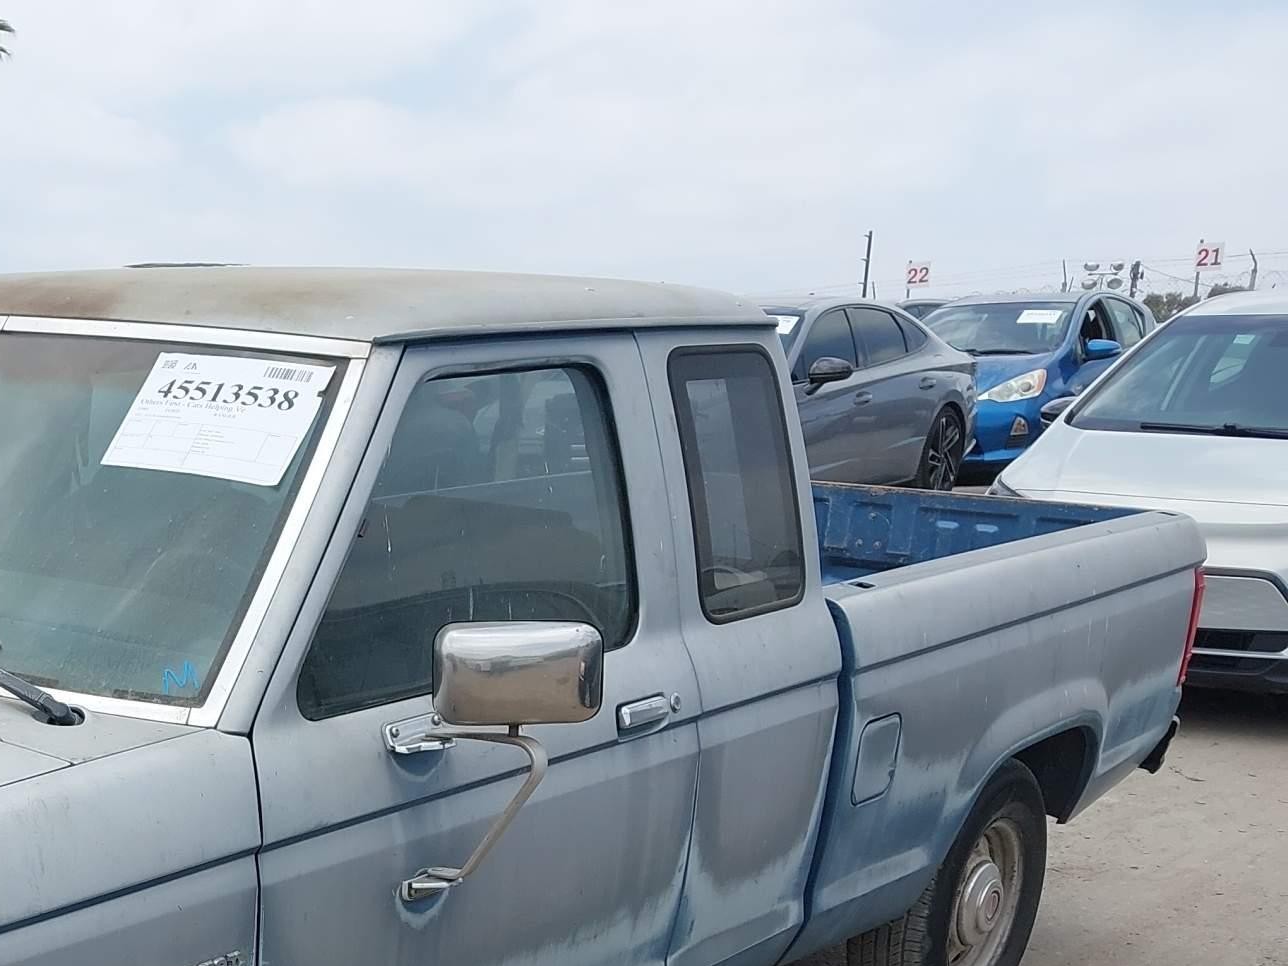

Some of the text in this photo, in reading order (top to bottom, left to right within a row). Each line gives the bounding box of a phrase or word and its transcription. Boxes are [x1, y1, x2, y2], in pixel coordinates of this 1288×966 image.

[1196, 247, 1222, 266] 21
[907, 267, 929, 284] 22
[157, 379, 300, 411] 45513538
